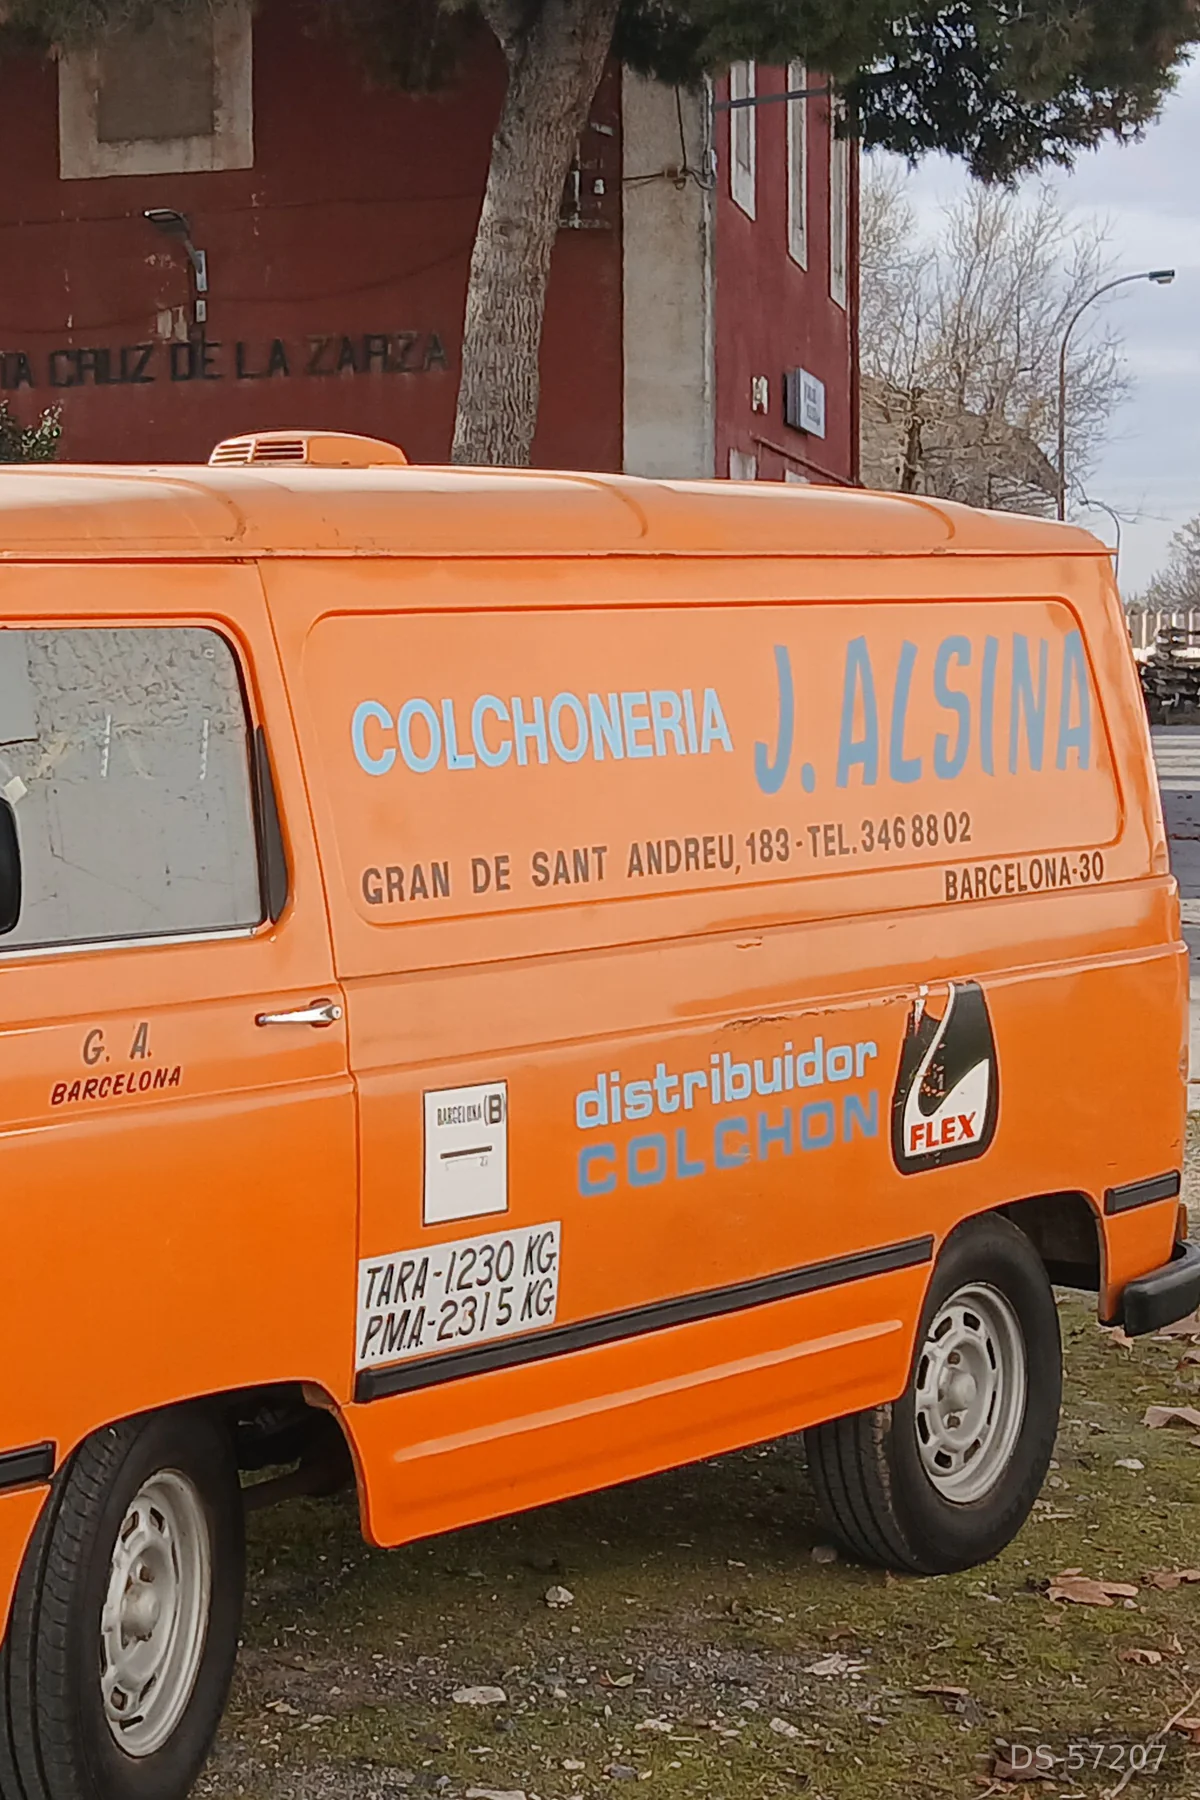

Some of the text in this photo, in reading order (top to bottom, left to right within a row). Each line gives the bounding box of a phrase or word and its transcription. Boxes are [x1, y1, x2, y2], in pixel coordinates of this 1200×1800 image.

[48, 343, 156, 388] CRUZ
[170, 341, 225, 382] DE
[236, 338, 290, 380] LA
[307, 331, 449, 376] ZARZA
[351, 628, 1093, 796] COLCHONERIA J. ALSINA
[361, 860, 450, 905] GRAN
[470, 854, 511, 894] DE
[531, 845, 608, 888] SANT
[82, 1028, 110, 1066] G.
[51, 1065, 182, 1106] BARCELONA
[574, 1036, 879, 1130] distribuidor
[576, 1089, 880, 1198] COLCHON
[909, 1111, 977, 1152] FLEX
